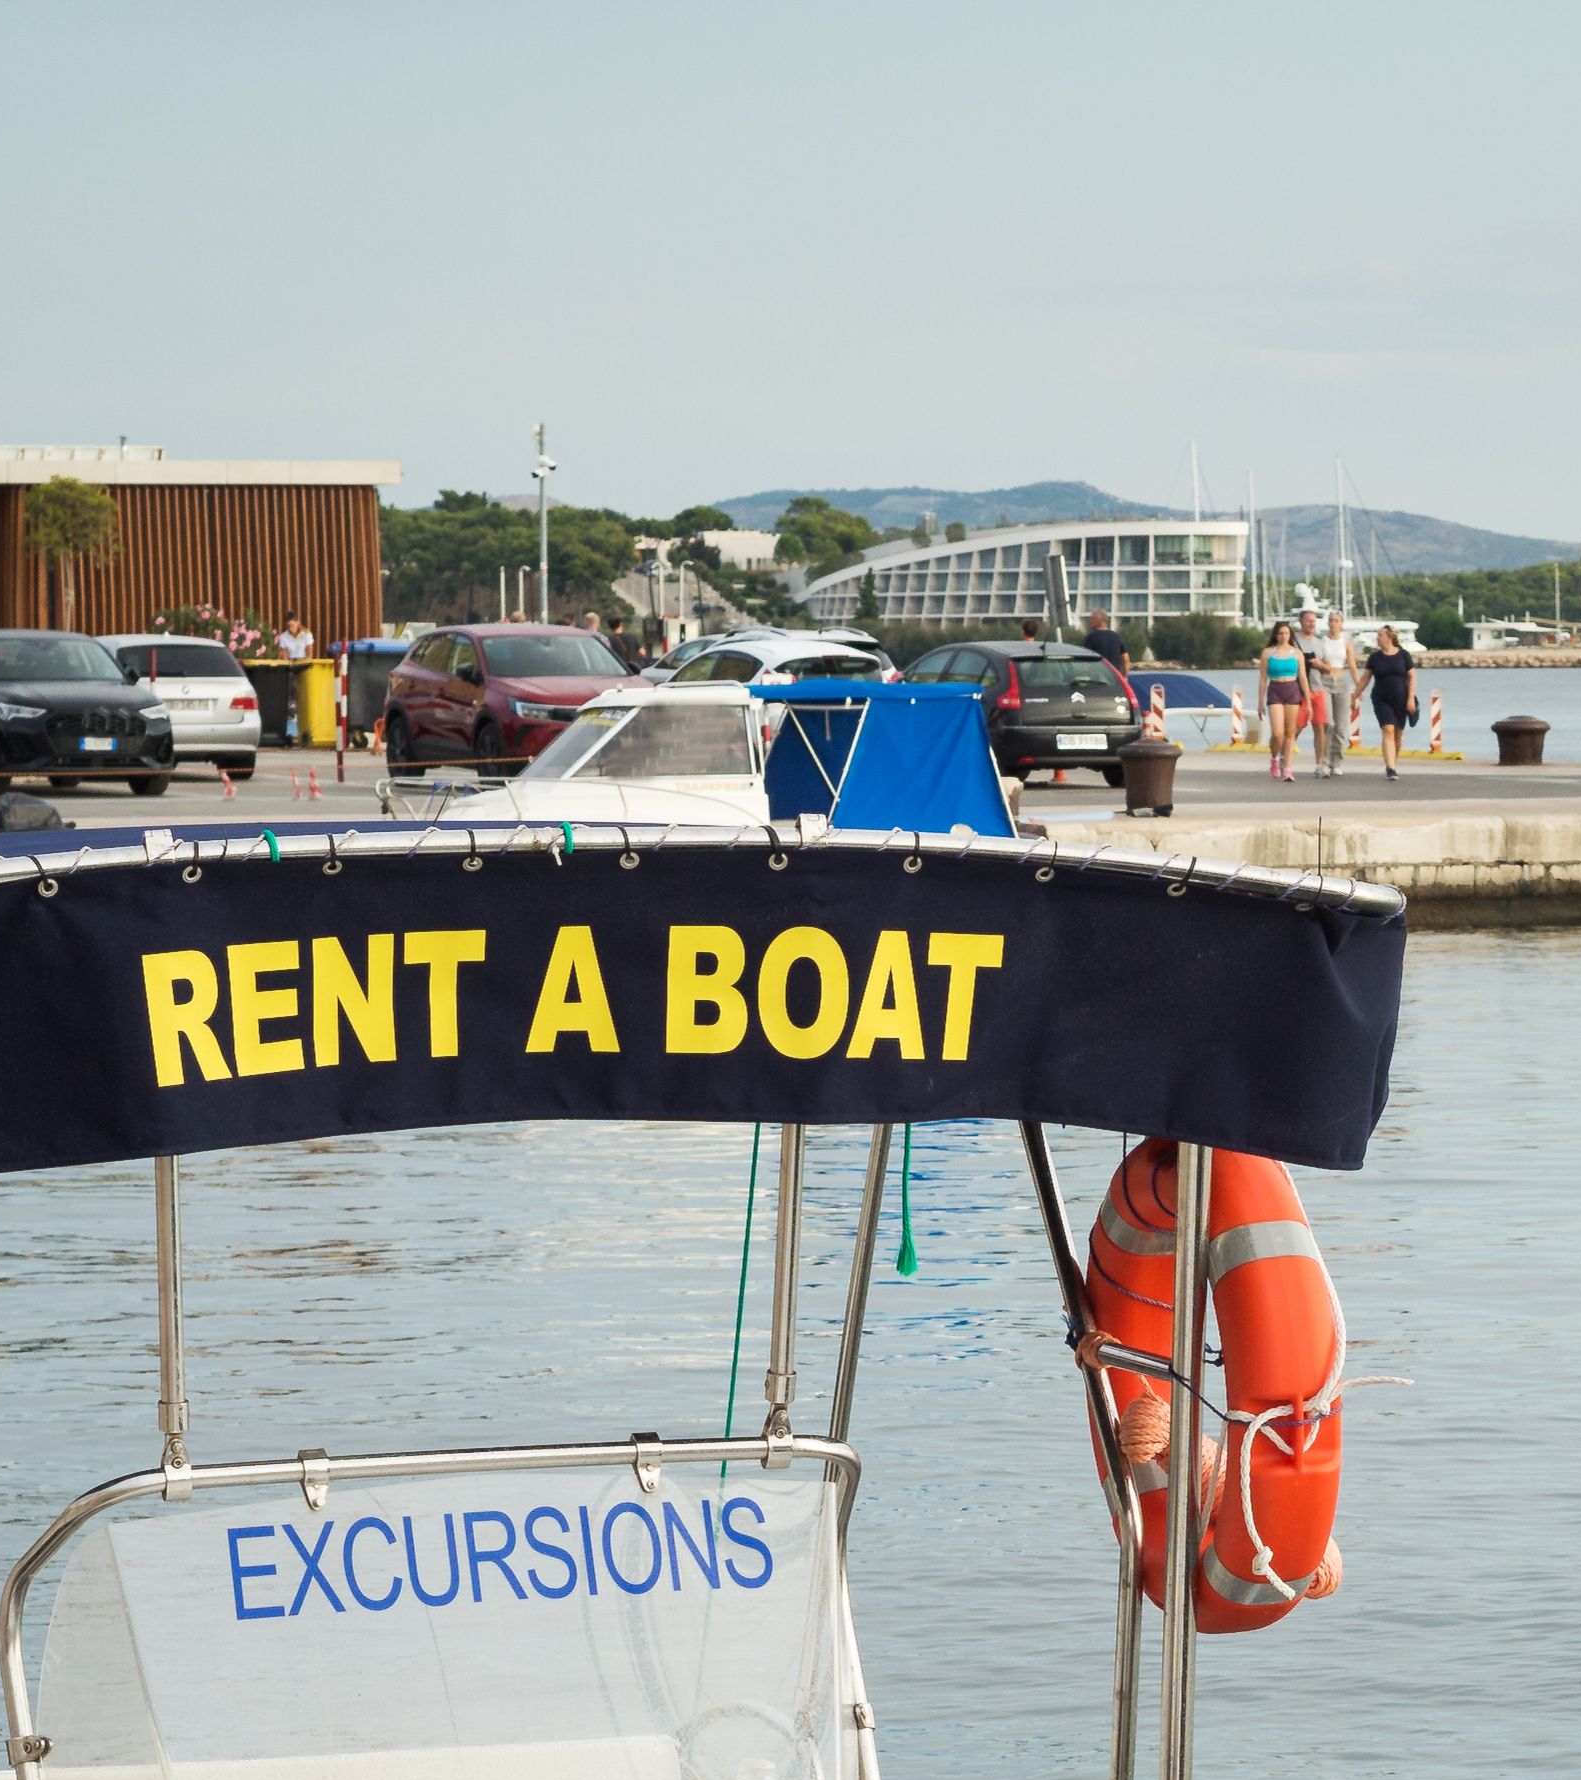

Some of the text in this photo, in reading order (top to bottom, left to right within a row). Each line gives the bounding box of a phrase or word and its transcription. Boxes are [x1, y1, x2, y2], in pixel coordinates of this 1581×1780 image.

[142, 925, 1005, 1087] RENT A BOAT
[227, 1497, 775, 1621] EXCURSIONS
